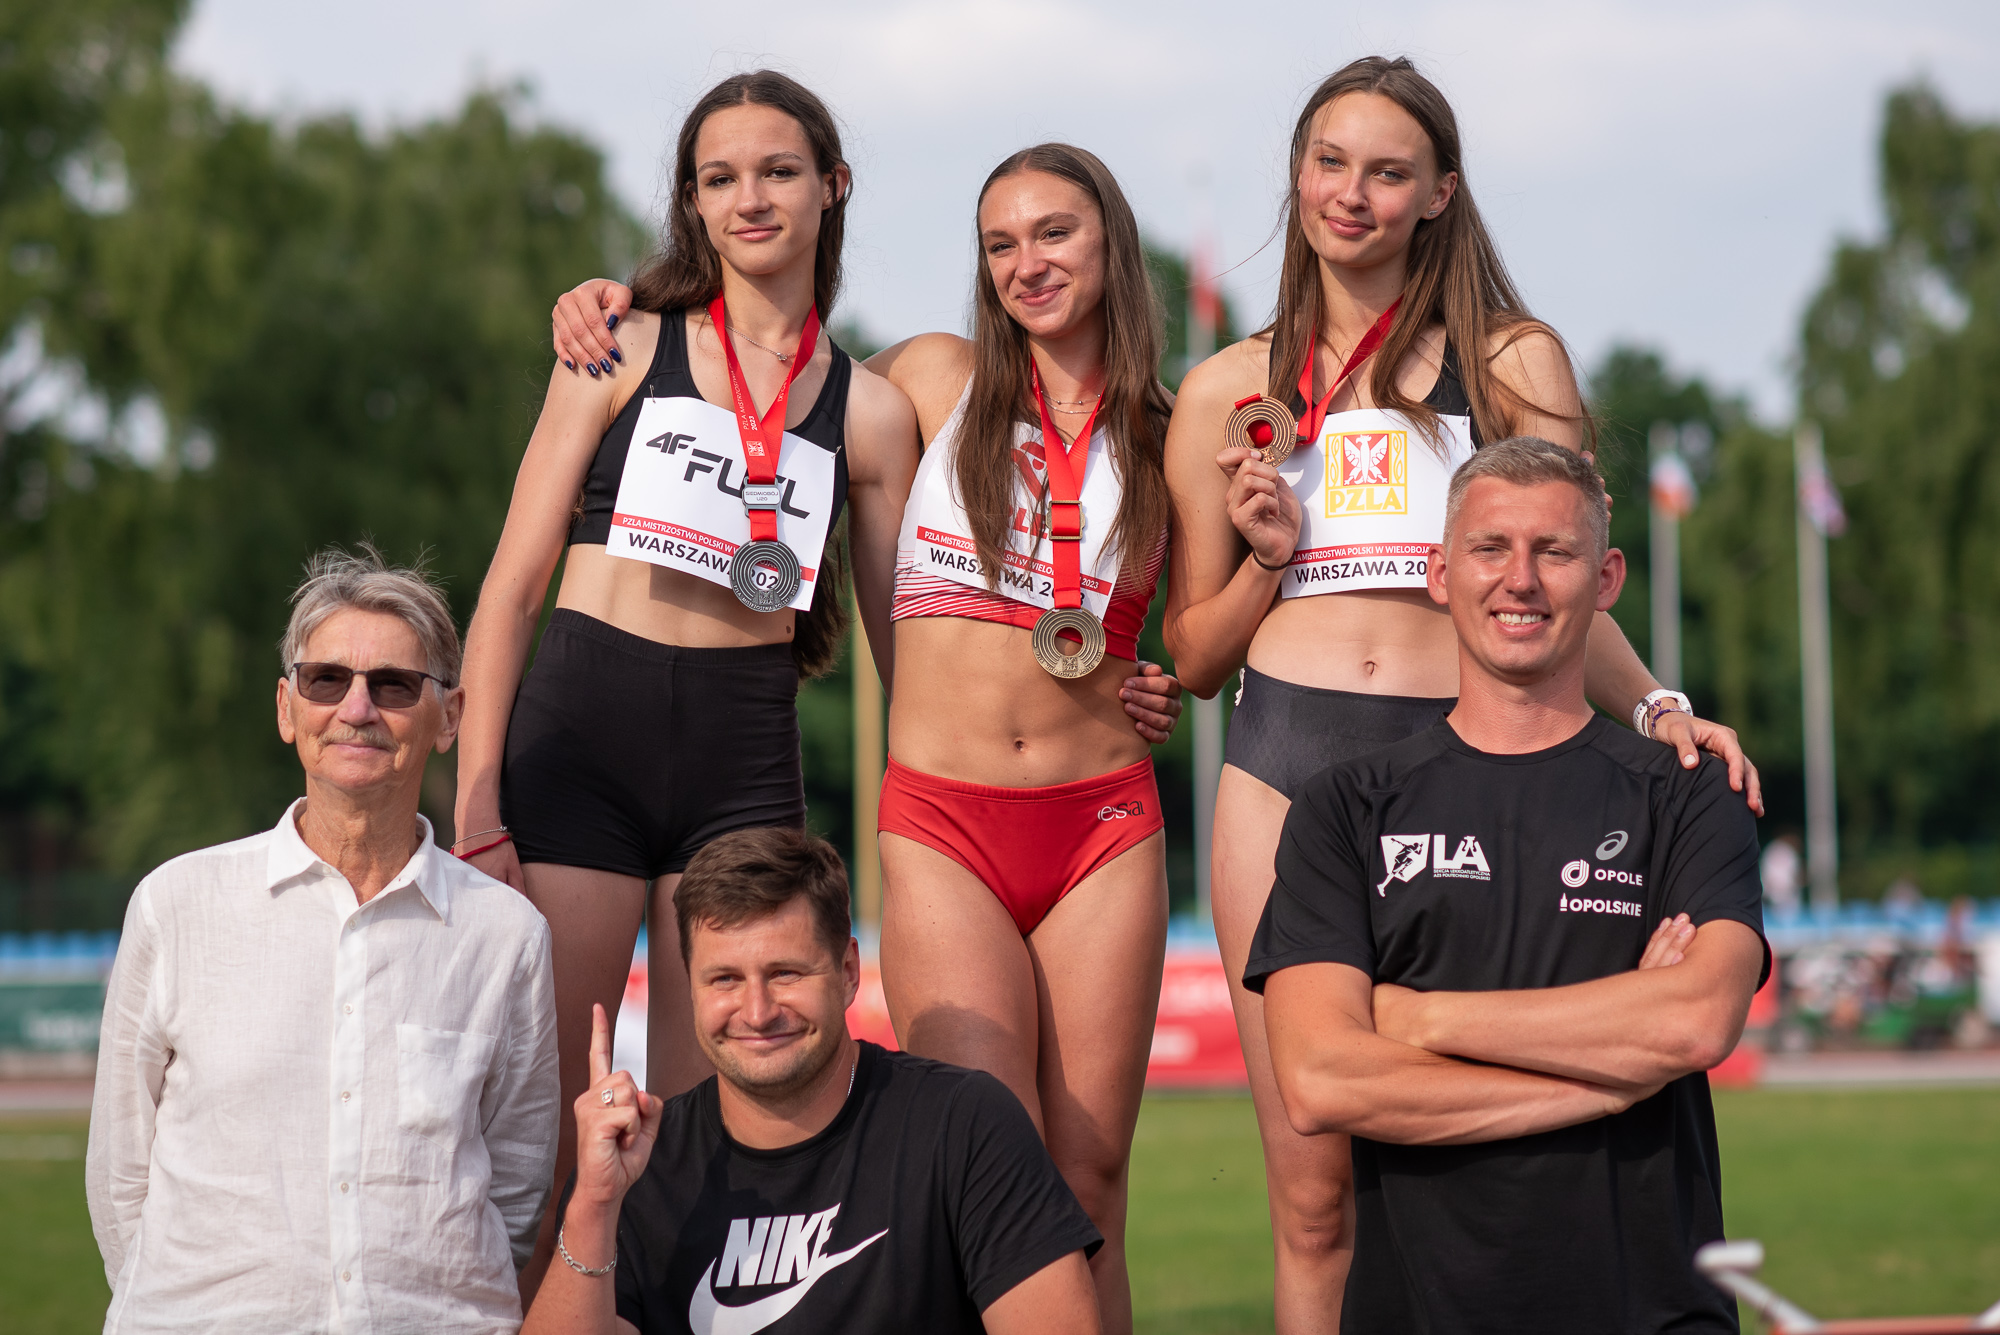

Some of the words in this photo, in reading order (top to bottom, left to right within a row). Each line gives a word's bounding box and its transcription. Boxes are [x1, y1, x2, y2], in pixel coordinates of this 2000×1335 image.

[748, 415, 758, 431] 2023
[646, 432, 697, 455] 4F
[684, 448, 810, 519] FUL
[1329, 487, 1403, 513] PZLA
[622, 516, 642, 527] PZLA
[642, 520, 698, 542] MISTRZOSTWA
[698, 535, 724, 549] POLSKI
[724, 545, 733, 553] W
[629, 532, 731, 576] WARSZAW
[925, 530, 940, 542] PZLA
[940, 534, 975, 551] MISTRZOS
[1081, 578, 1099, 589] 2023
[1302, 549, 1347, 560] MISTRZOSTWA
[1347, 546, 1374, 556] POLSKI
[1375, 546, 1385, 554] W
[1385, 545, 1430, 554] WIELOBOJA
[1295, 560, 1399, 584] WARSZAWA
[1404, 560, 1427, 576] 20
[1433, 834, 1490, 872] LA
[1594, 868, 1643, 886] OPOLE
[1569, 898, 1642, 917] OPOLSKIE
[715, 1202, 841, 1288] NIKE
